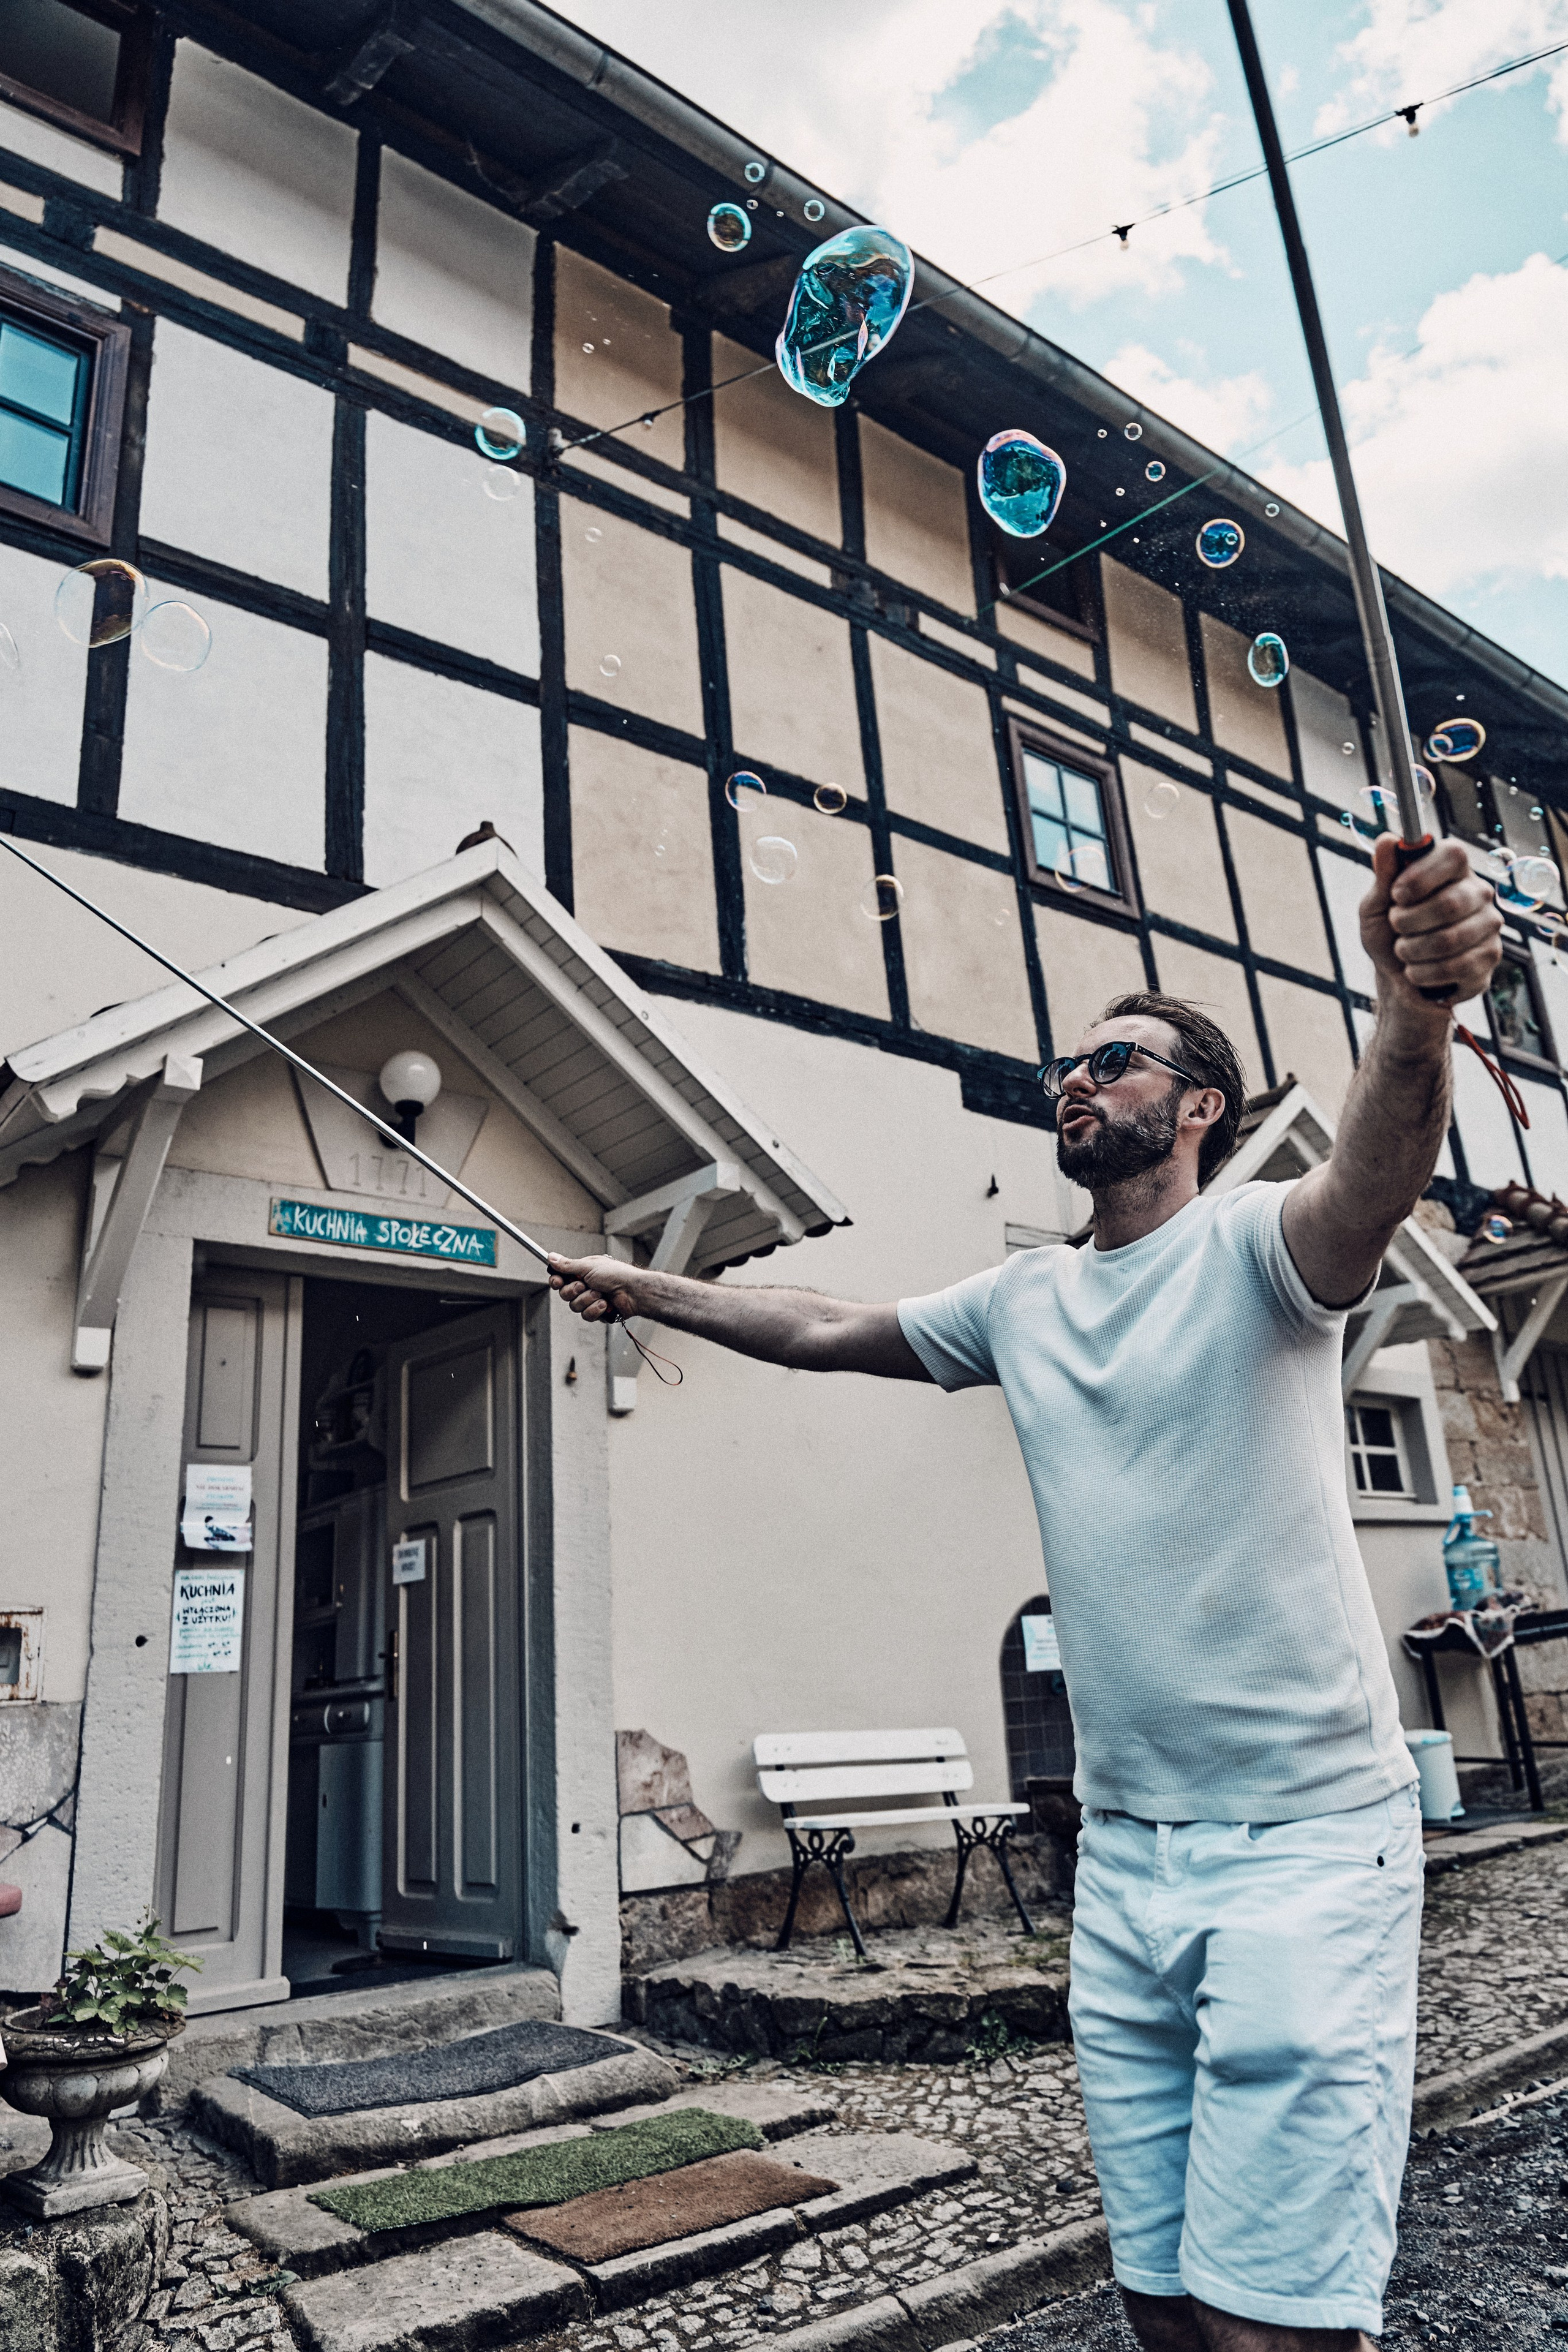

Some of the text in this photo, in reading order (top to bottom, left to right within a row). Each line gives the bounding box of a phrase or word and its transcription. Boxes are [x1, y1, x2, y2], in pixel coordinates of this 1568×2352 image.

[349, 1153, 427, 1197] 1771
[293, 1205, 484, 1256] KUCHNIA SPOŁECZNA
[180, 1581, 235, 1600] KUCHNIA
[183, 1616, 188, 1625] Z
